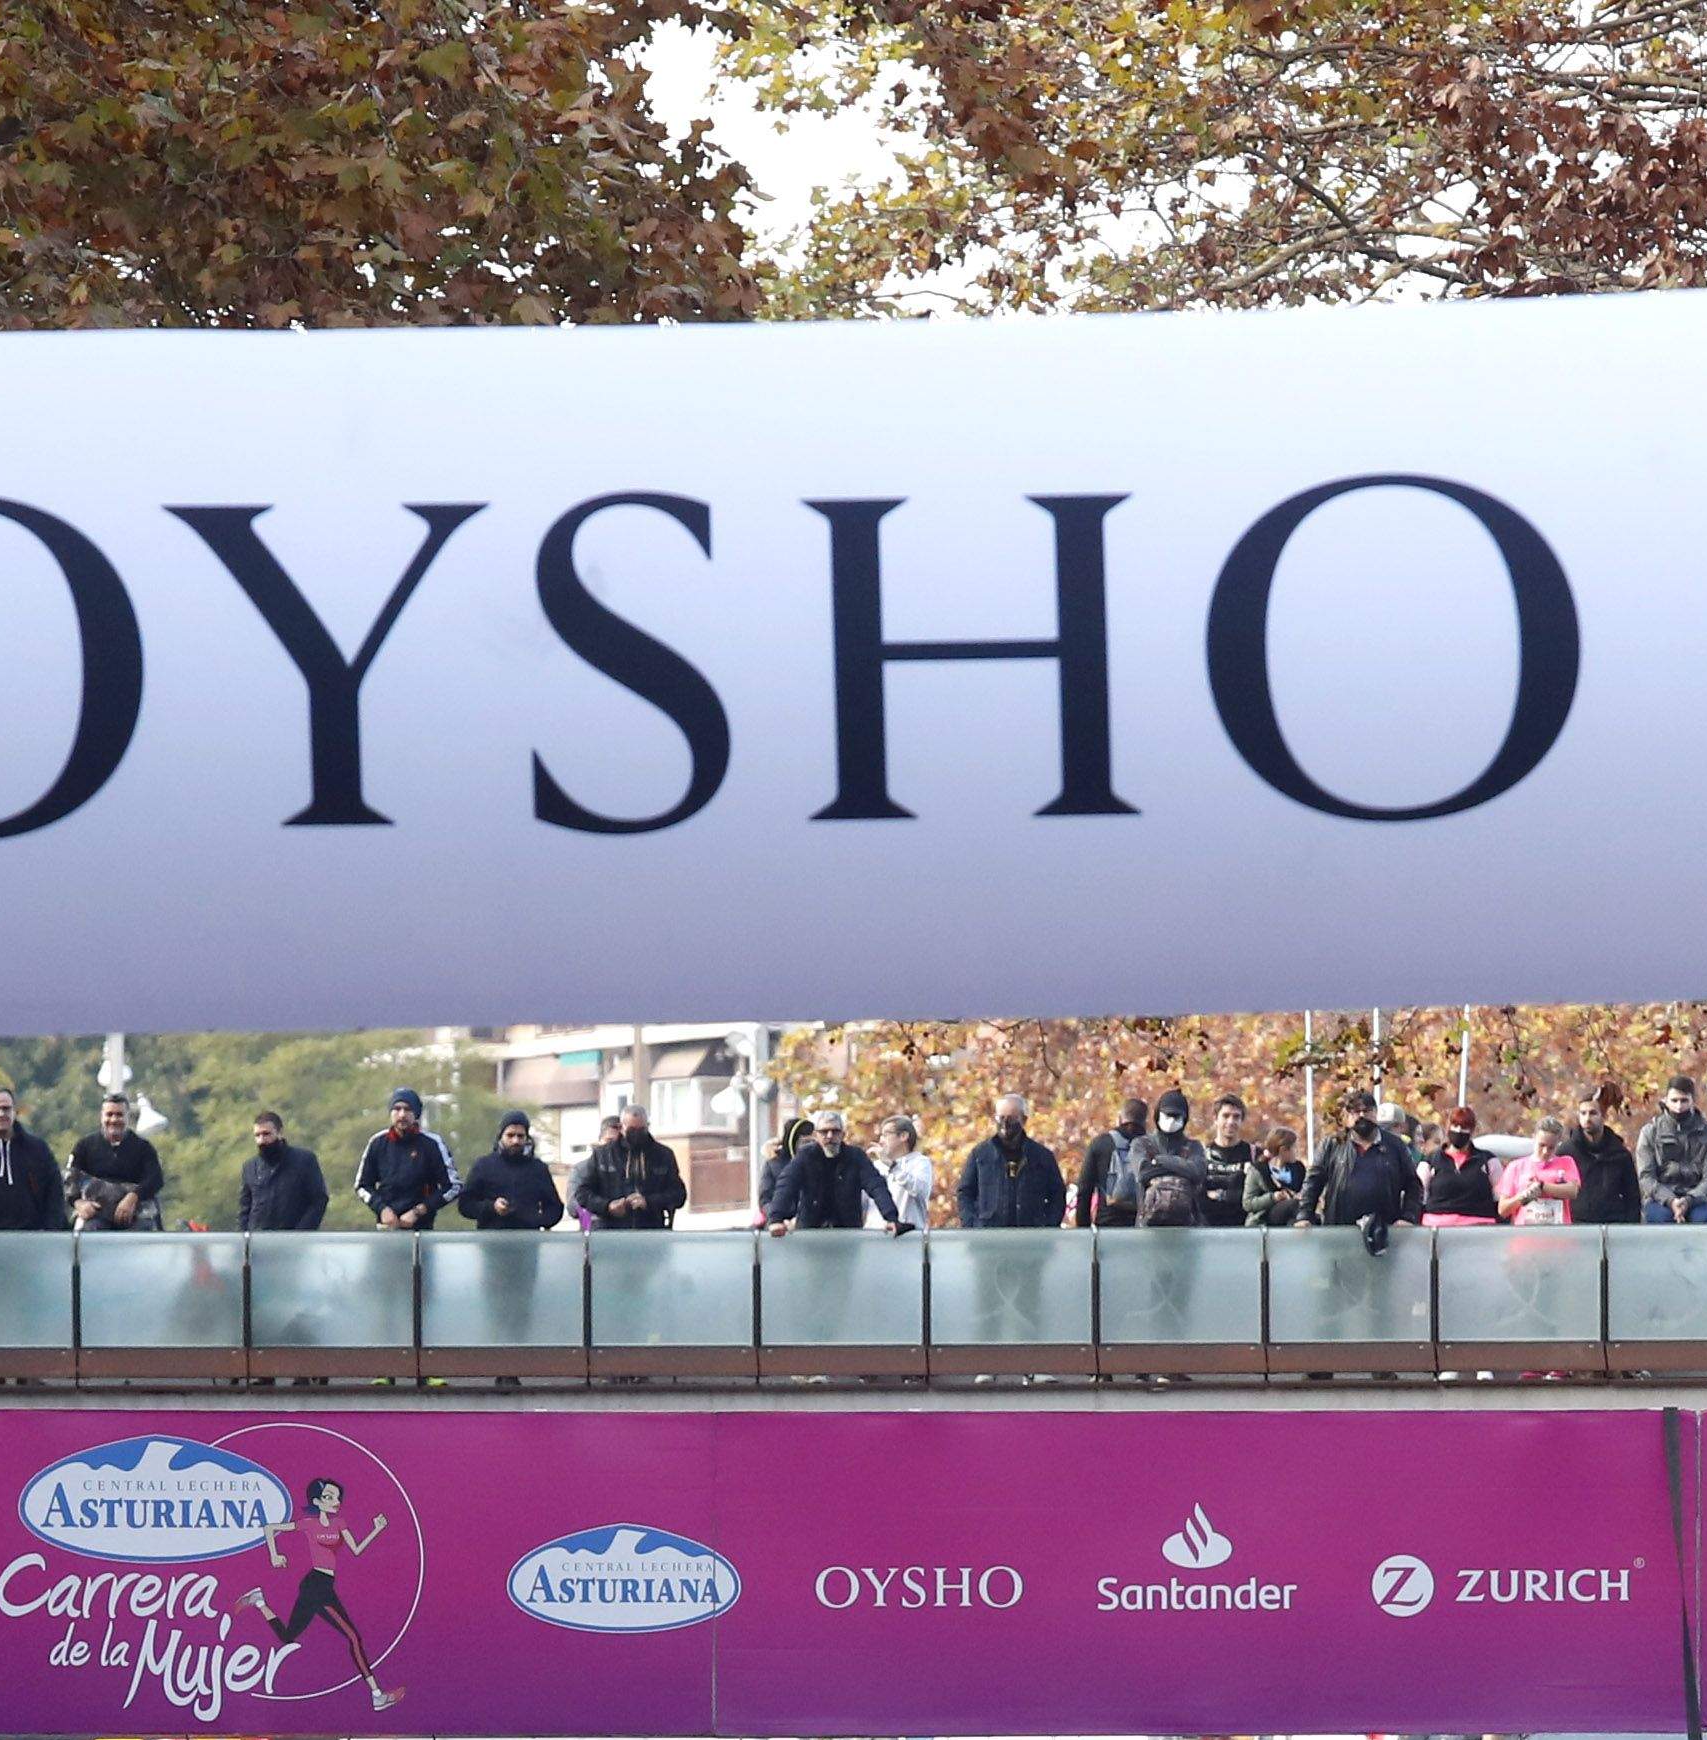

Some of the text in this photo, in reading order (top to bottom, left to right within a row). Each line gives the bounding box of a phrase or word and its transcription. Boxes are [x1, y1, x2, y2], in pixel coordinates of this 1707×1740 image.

[82, 1479, 263, 1492] CENTRAL LECHERA
[40, 1482, 268, 1530] ASTURIANA
[526, 1564, 720, 1604] ASTURIANA
[561, 1562, 633, 1572] CENTRAL
[815, 1565, 1023, 1609] OYSHO
[1097, 1577, 1298, 1611] Santander
[49, 1612, 302, 1723] de la Mujer
